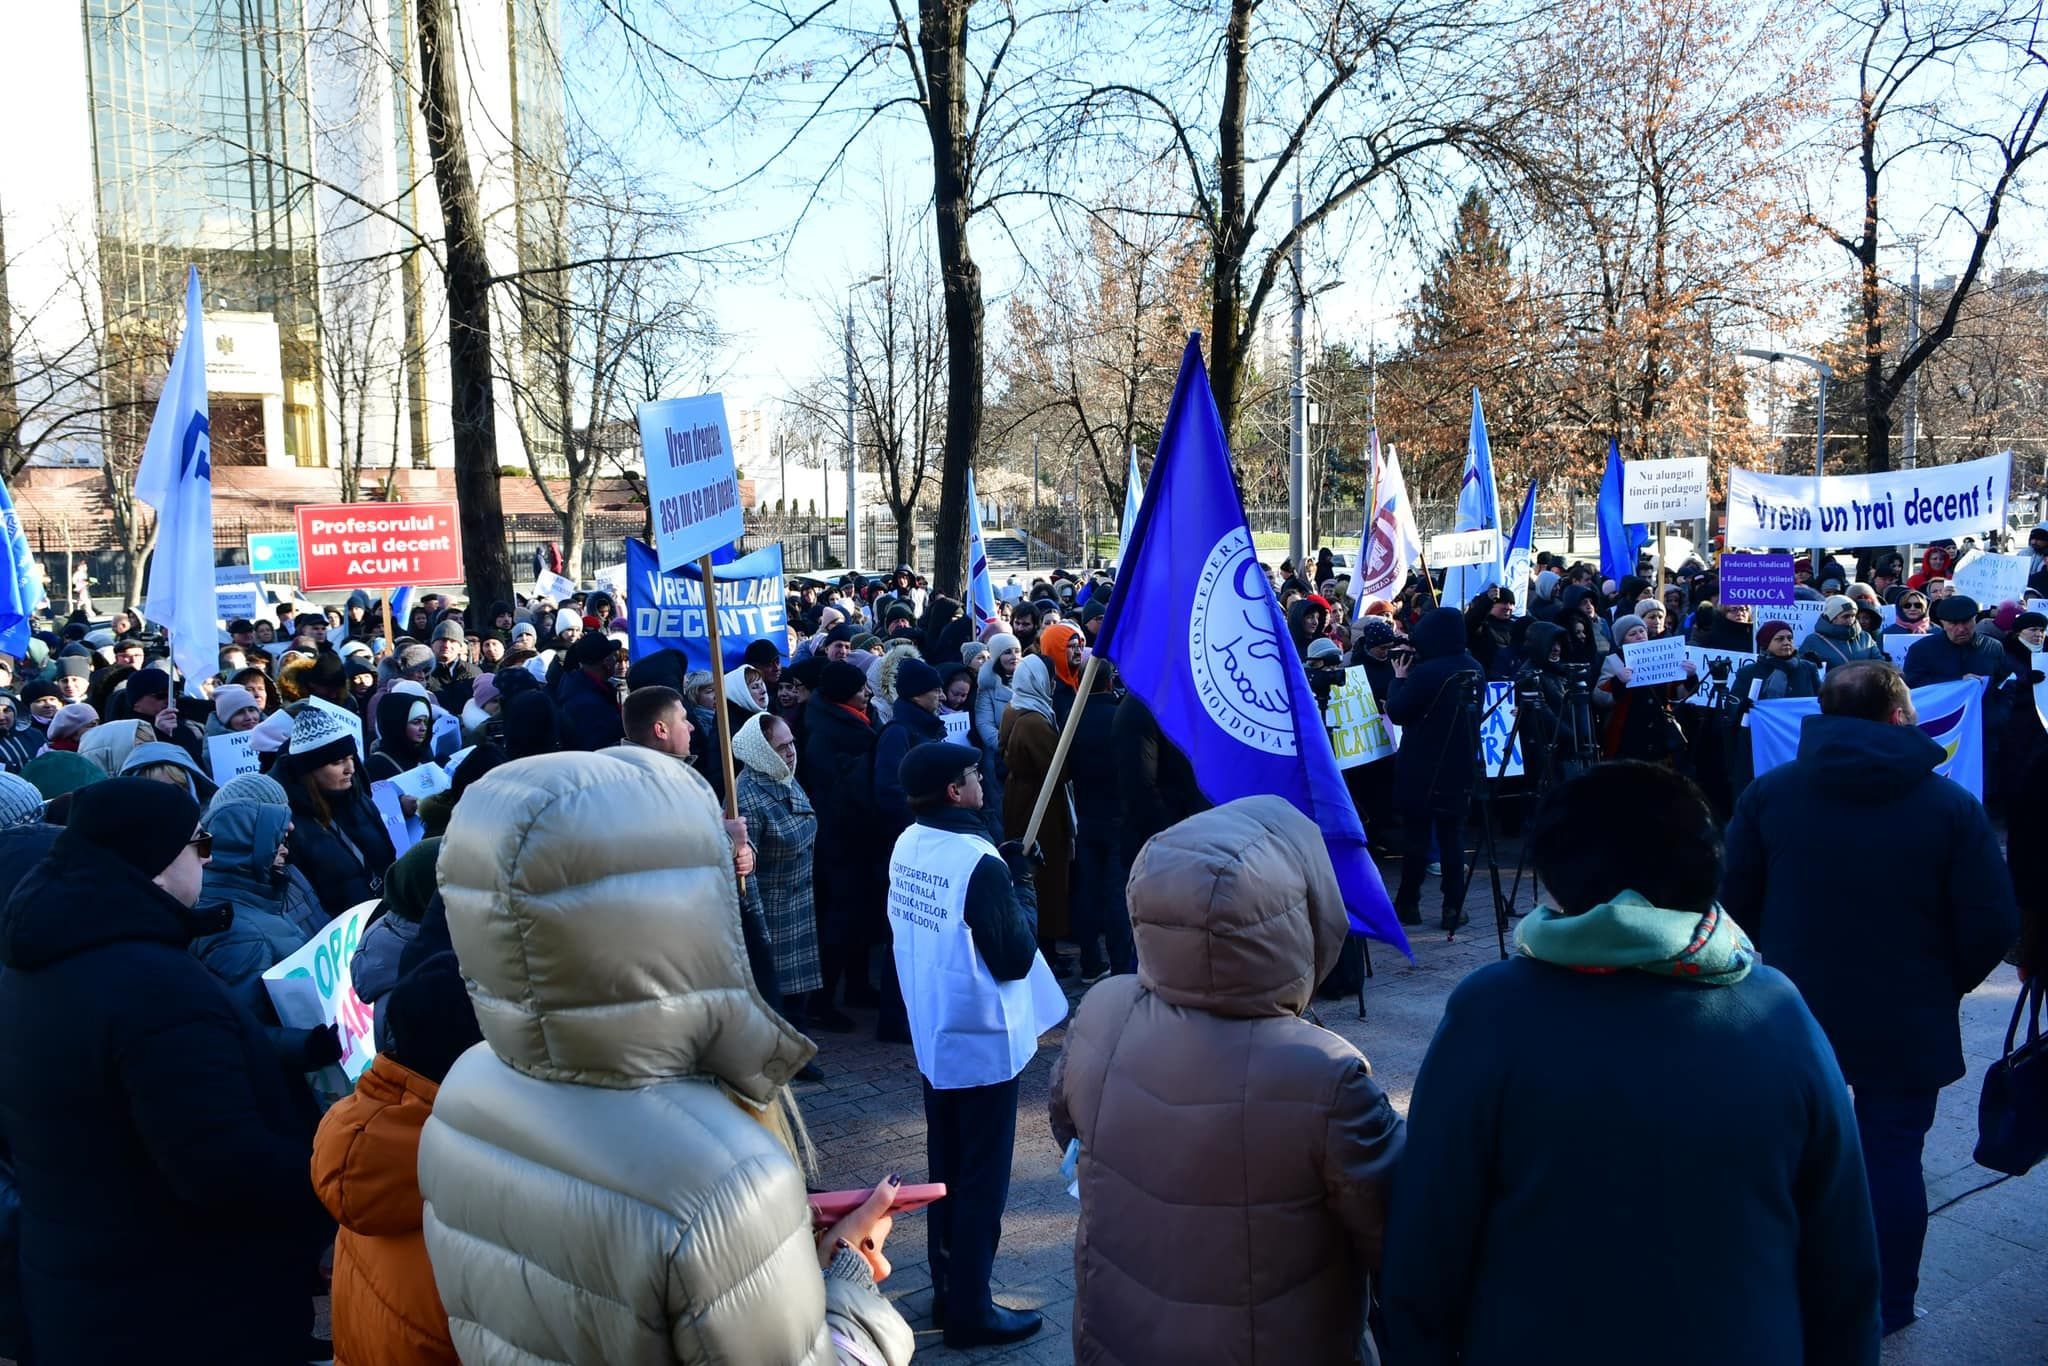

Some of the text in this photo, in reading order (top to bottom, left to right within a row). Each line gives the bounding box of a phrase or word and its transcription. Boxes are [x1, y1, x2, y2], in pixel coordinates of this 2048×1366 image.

[665, 427, 693, 468] Vrem
[1640, 471, 1653, 481] Nu
[1629, 481, 1702, 497] tinerii pedagogi
[679, 490, 693, 526] nu
[692, 487, 704, 523] se
[1643, 500, 1659, 511] din
[1751, 475, 1993, 532] Vrem un trai decent !
[311, 516, 434, 535] Profesorului
[311, 542, 338, 556] un
[342, 538, 377, 554] trai
[382, 536, 450, 554] decent
[347, 557, 420, 575] ACUM !
[1724, 560, 1757, 569] Federația
[1727, 575, 1759, 583] Educației
[648, 571, 704, 606] VREM
[1729, 588, 1786, 599] SOROCA
[332, 711, 358, 729] VREM
[1200, 679, 1283, 749] MOLDOVA
[902, 910, 940, 933] MOLDOVA
